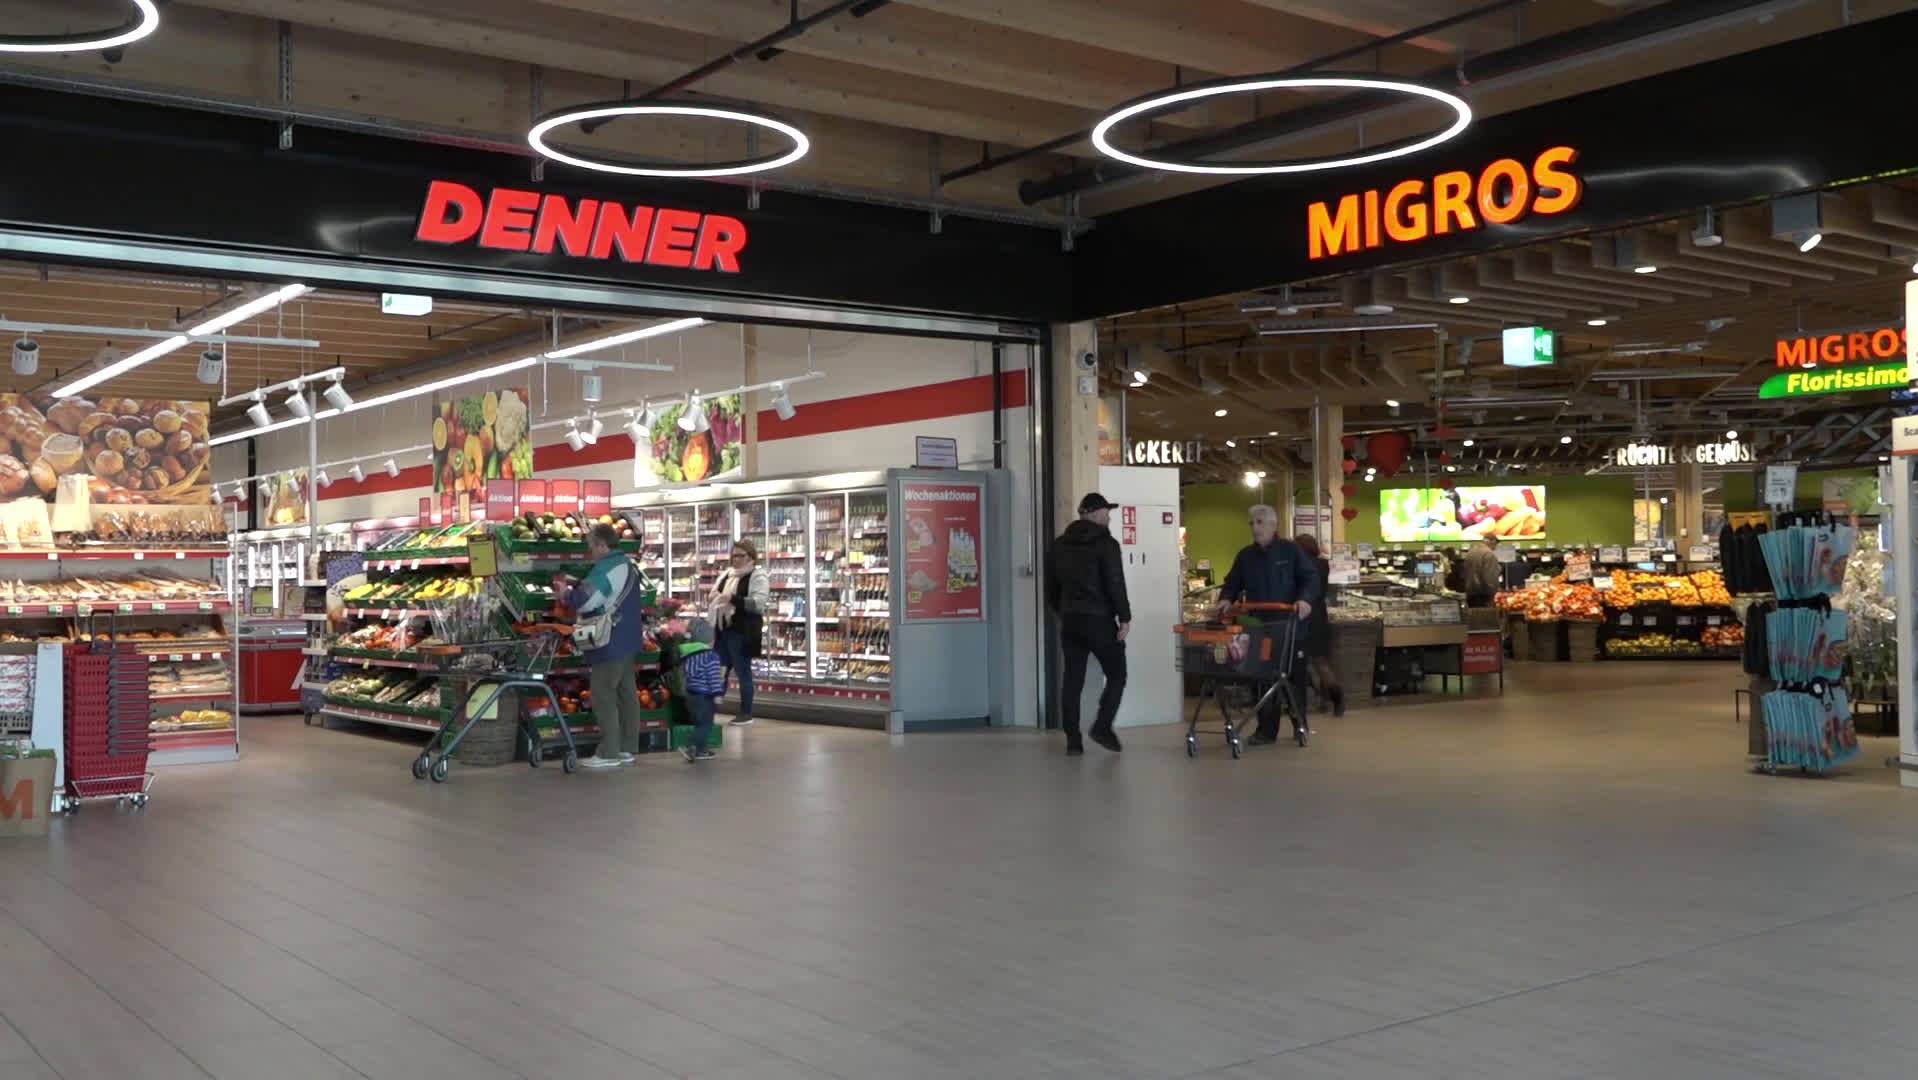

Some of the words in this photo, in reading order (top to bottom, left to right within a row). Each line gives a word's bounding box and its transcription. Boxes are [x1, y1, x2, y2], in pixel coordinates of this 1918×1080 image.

[416, 180, 747, 272] DENNER
[1308, 146, 1580, 260] MIGROS
[1776, 328, 1907, 368] MIGRO
[1787, 366, 1909, 393] Florissimo
